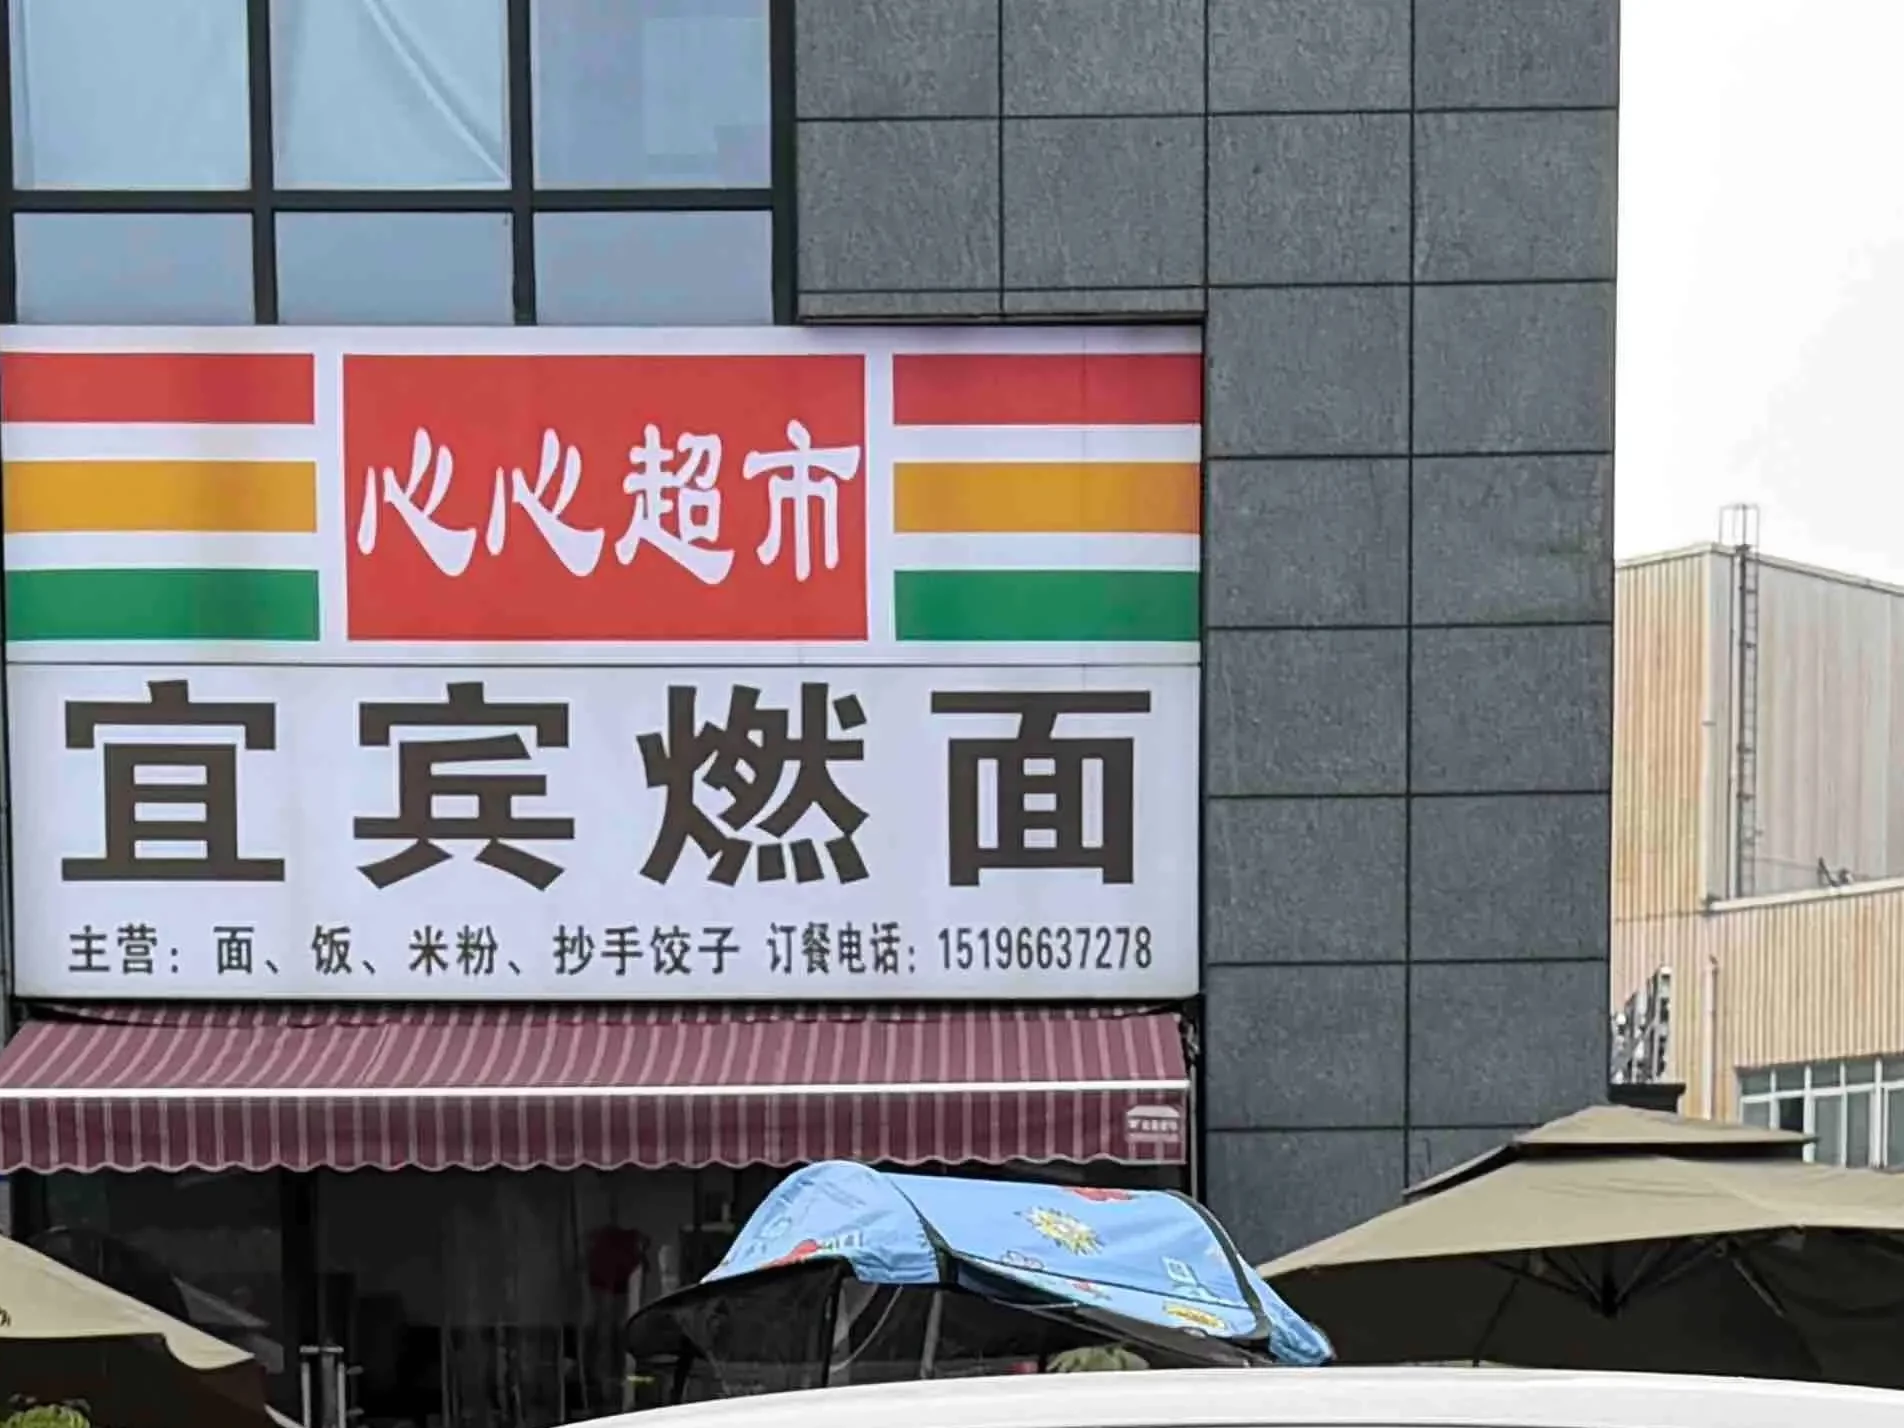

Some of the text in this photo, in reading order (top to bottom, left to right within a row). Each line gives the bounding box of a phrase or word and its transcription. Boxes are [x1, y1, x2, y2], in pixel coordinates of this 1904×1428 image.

[356, 418, 862, 585] 心心超市
[60, 678, 1152, 891] 宜宾燃面
